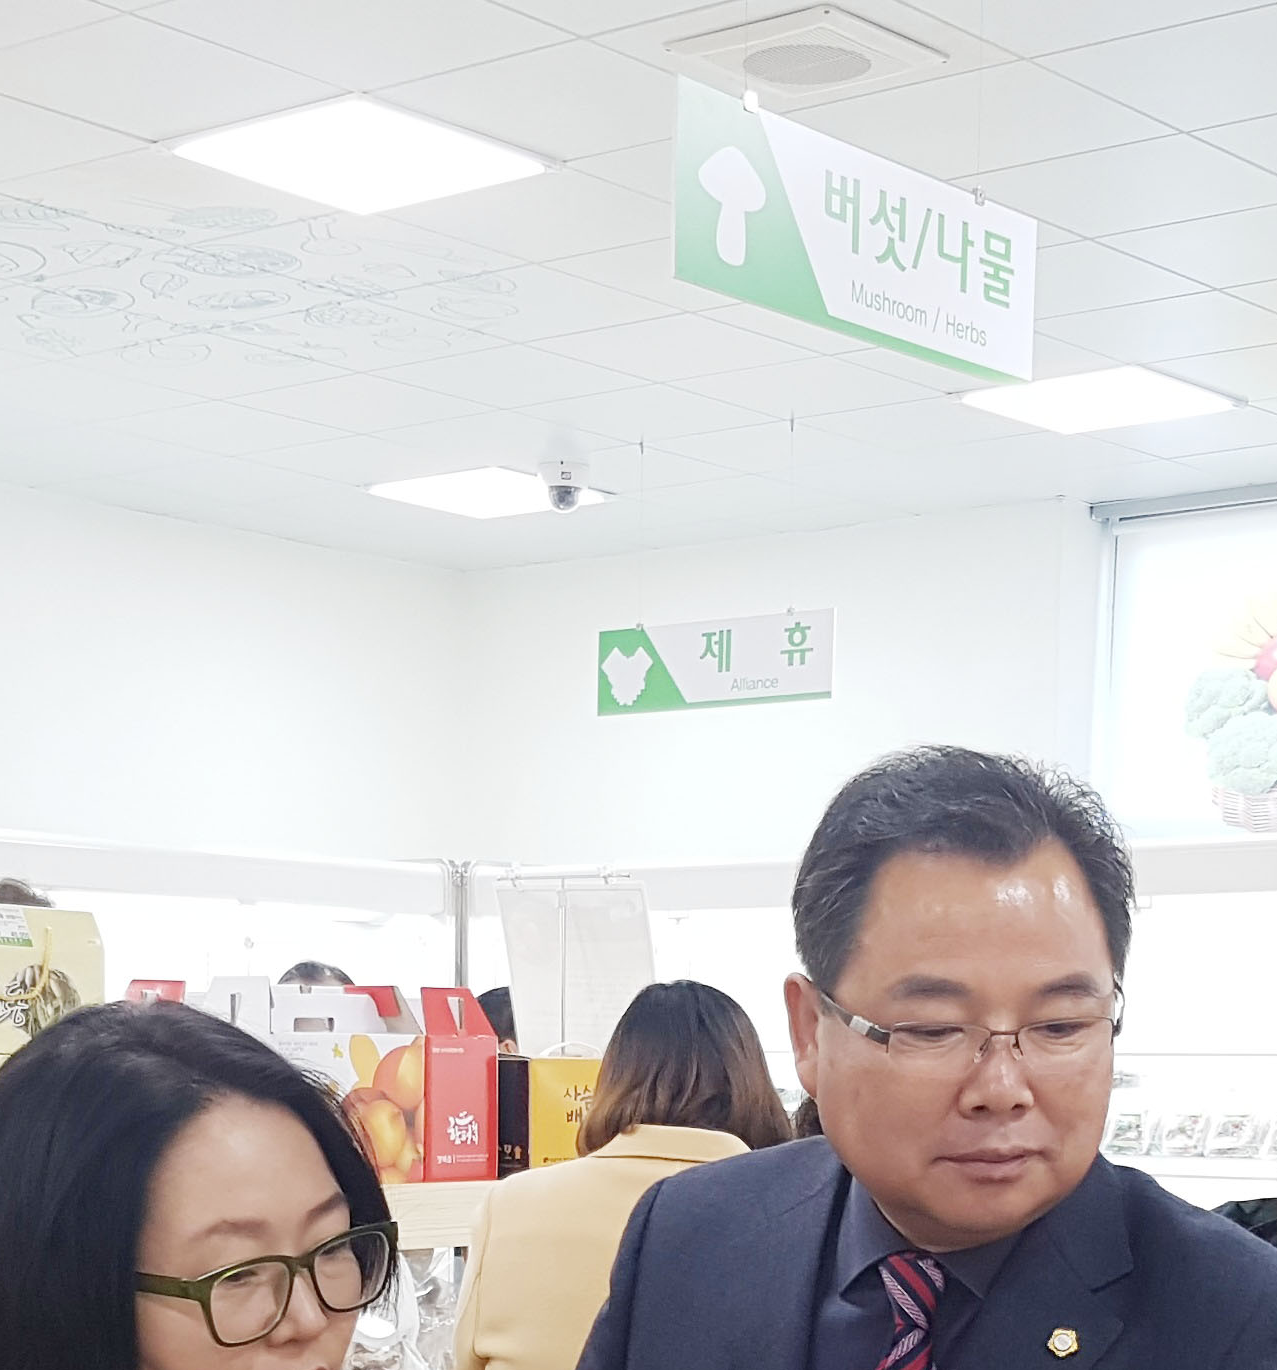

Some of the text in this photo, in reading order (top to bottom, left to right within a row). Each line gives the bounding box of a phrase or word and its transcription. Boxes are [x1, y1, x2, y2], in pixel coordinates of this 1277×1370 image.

[824, 168, 1015, 310] 버섯/나물
[851, 279, 928, 328] Mushroom
[945, 314, 988, 348] Herbs
[730, 676, 779, 692] Alliance
